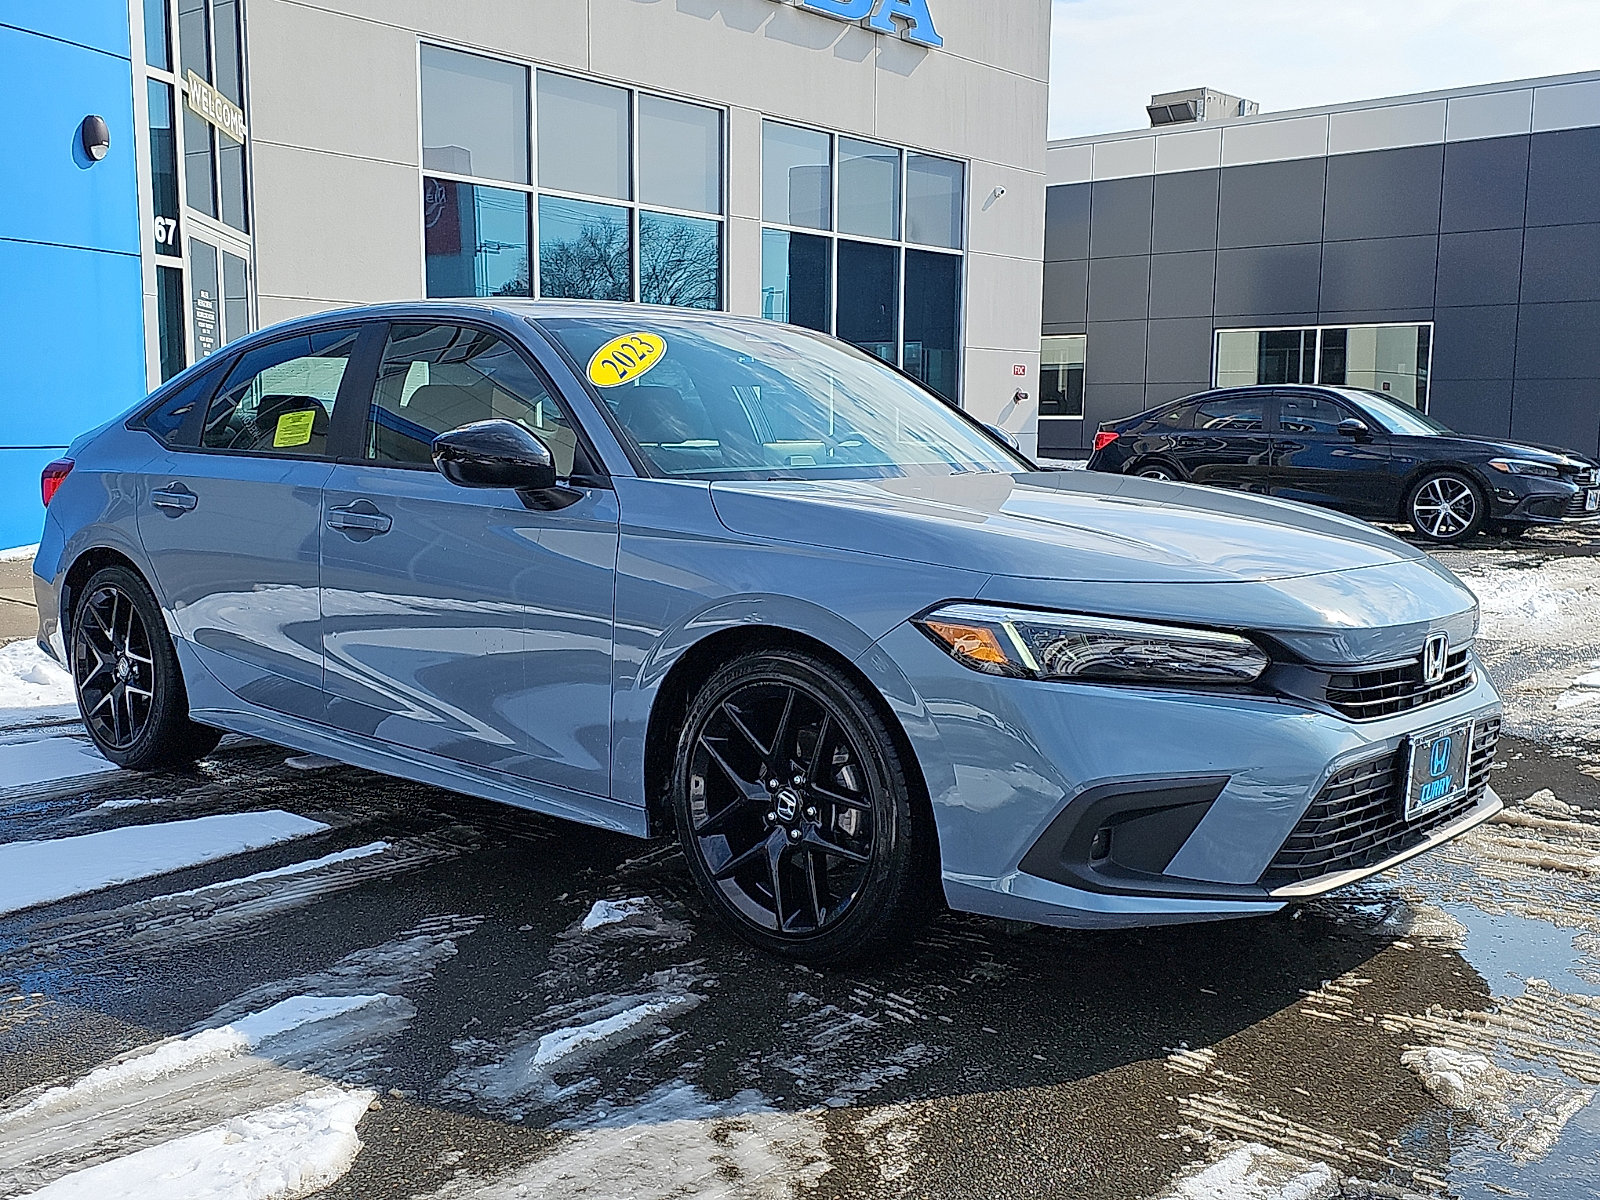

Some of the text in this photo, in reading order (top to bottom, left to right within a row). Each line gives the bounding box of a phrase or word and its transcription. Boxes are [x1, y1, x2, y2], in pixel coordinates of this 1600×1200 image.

[188, 76, 245, 139] WELCOME
[154, 215, 177, 246] 67
[601, 336, 655, 379] 2023
[1420, 775, 1453, 803] CURRY
